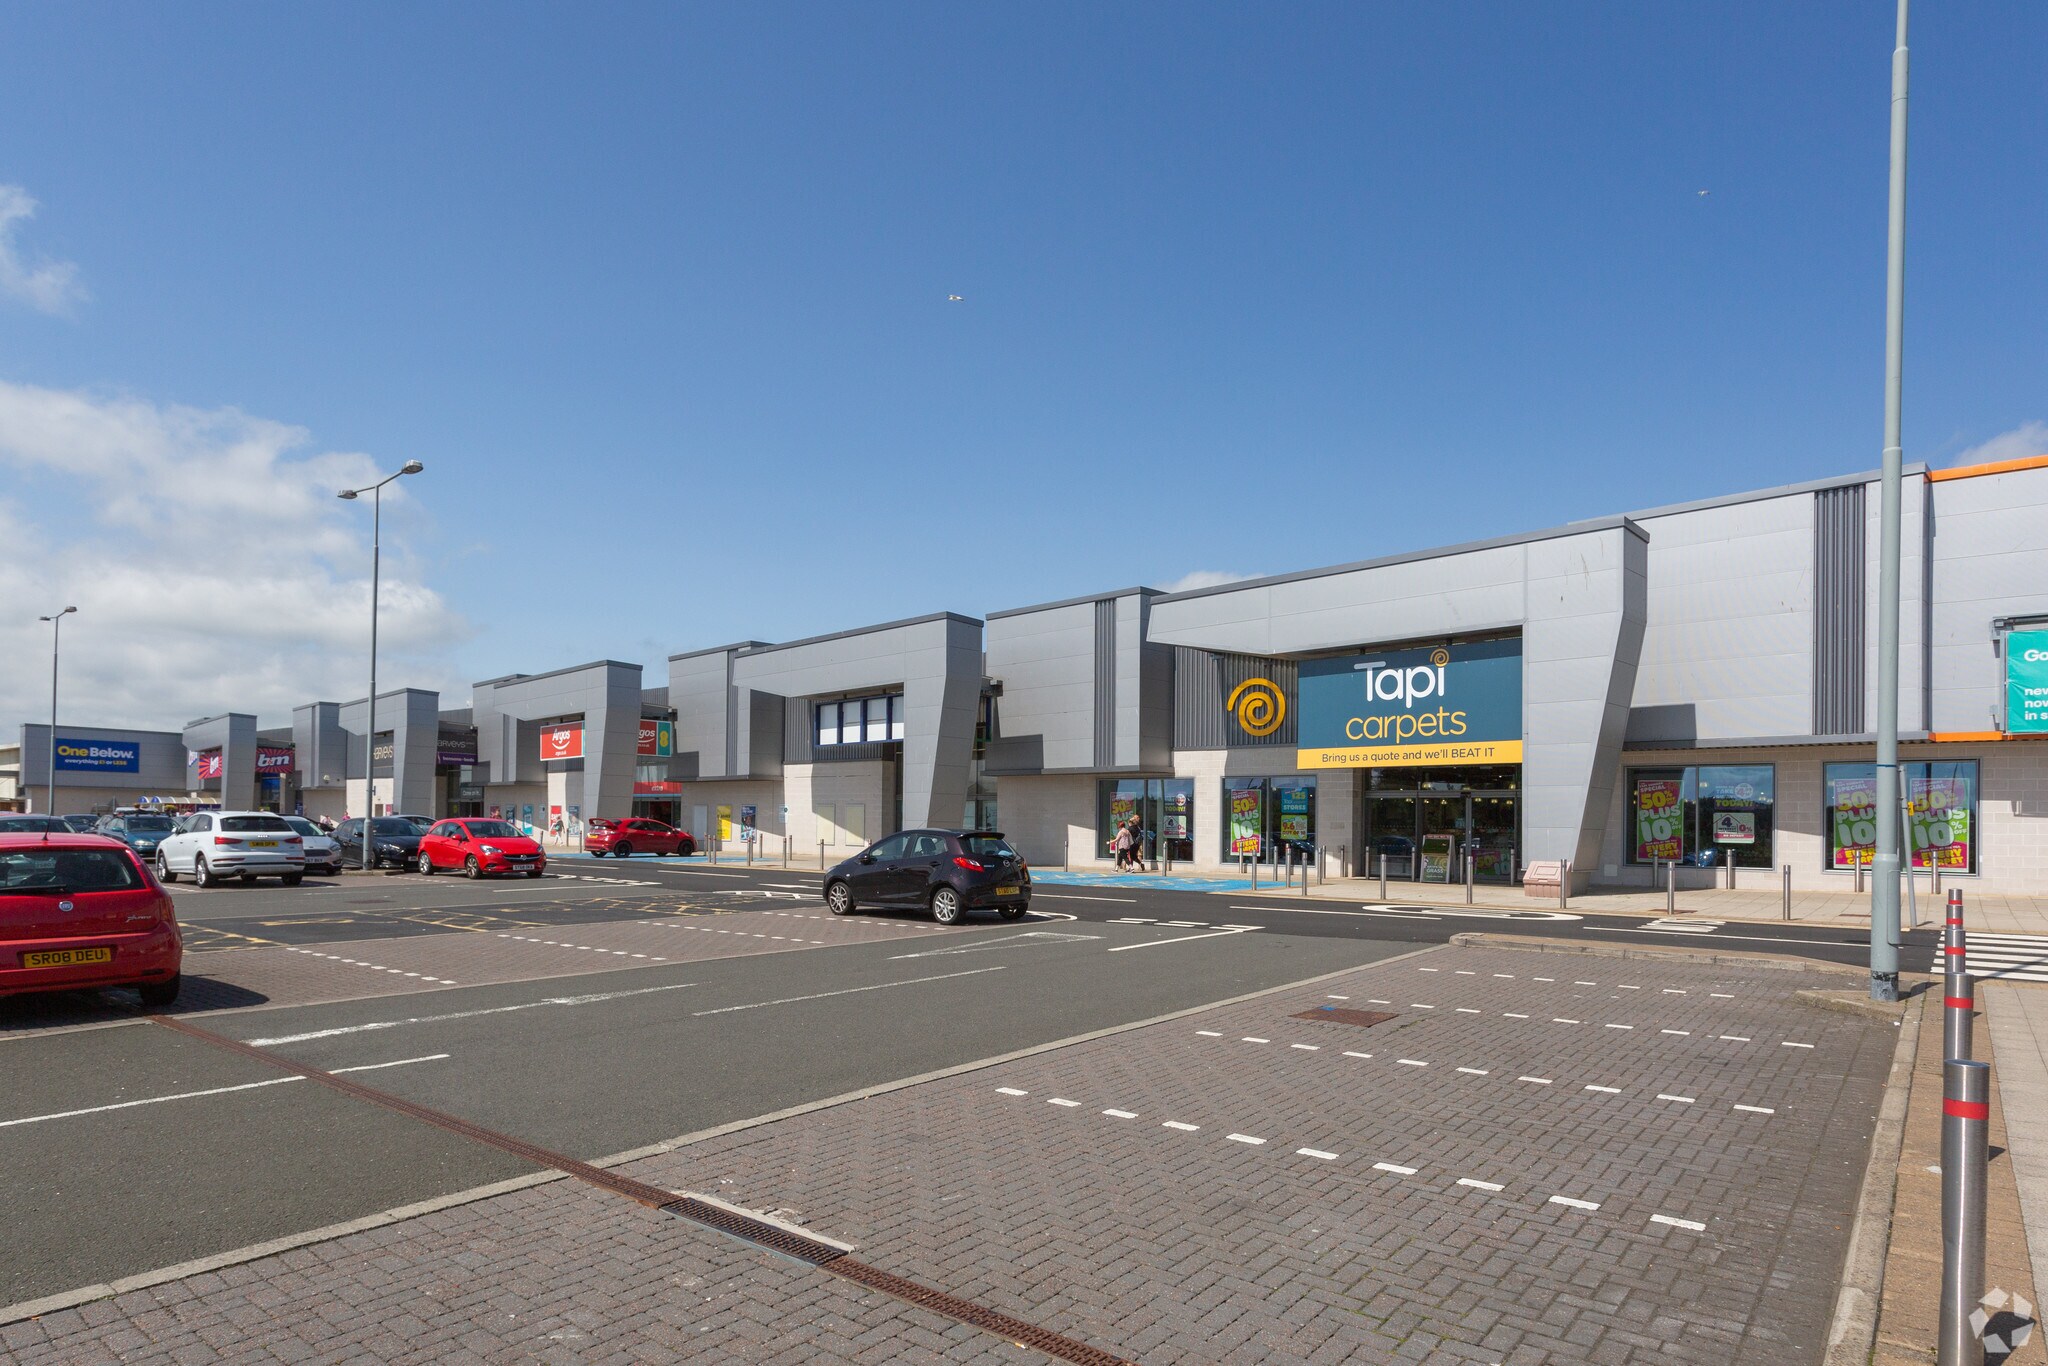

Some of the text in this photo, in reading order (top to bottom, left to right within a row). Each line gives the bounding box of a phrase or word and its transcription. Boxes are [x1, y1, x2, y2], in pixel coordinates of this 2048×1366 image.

[1354, 648, 1449, 708] Tapi
[2024, 711, 2037, 720] in
[1345, 706, 1467, 743] carpets
[552, 729, 571, 744] Argos
[638, 729, 656, 739] gos
[58, 745, 89, 757] One
[1322, 747, 1495, 763] Bring us a quote and we'll BEAT IT
[64, 758, 99, 766] everything
[1640, 785, 1667, 793] SPECIAL
[1232, 809, 1259, 824] PLUS
[1640, 805, 1681, 821] PLUS
[1835, 808, 1876, 823] PLU
[1912, 806, 1966, 825] PLUS
[1721, 817, 1733, 828] 4
[1647, 849, 1680, 859] CRPET
[1922, 856, 1964, 867] CRPET
[31, 950, 103, 966] SR08 DEU
